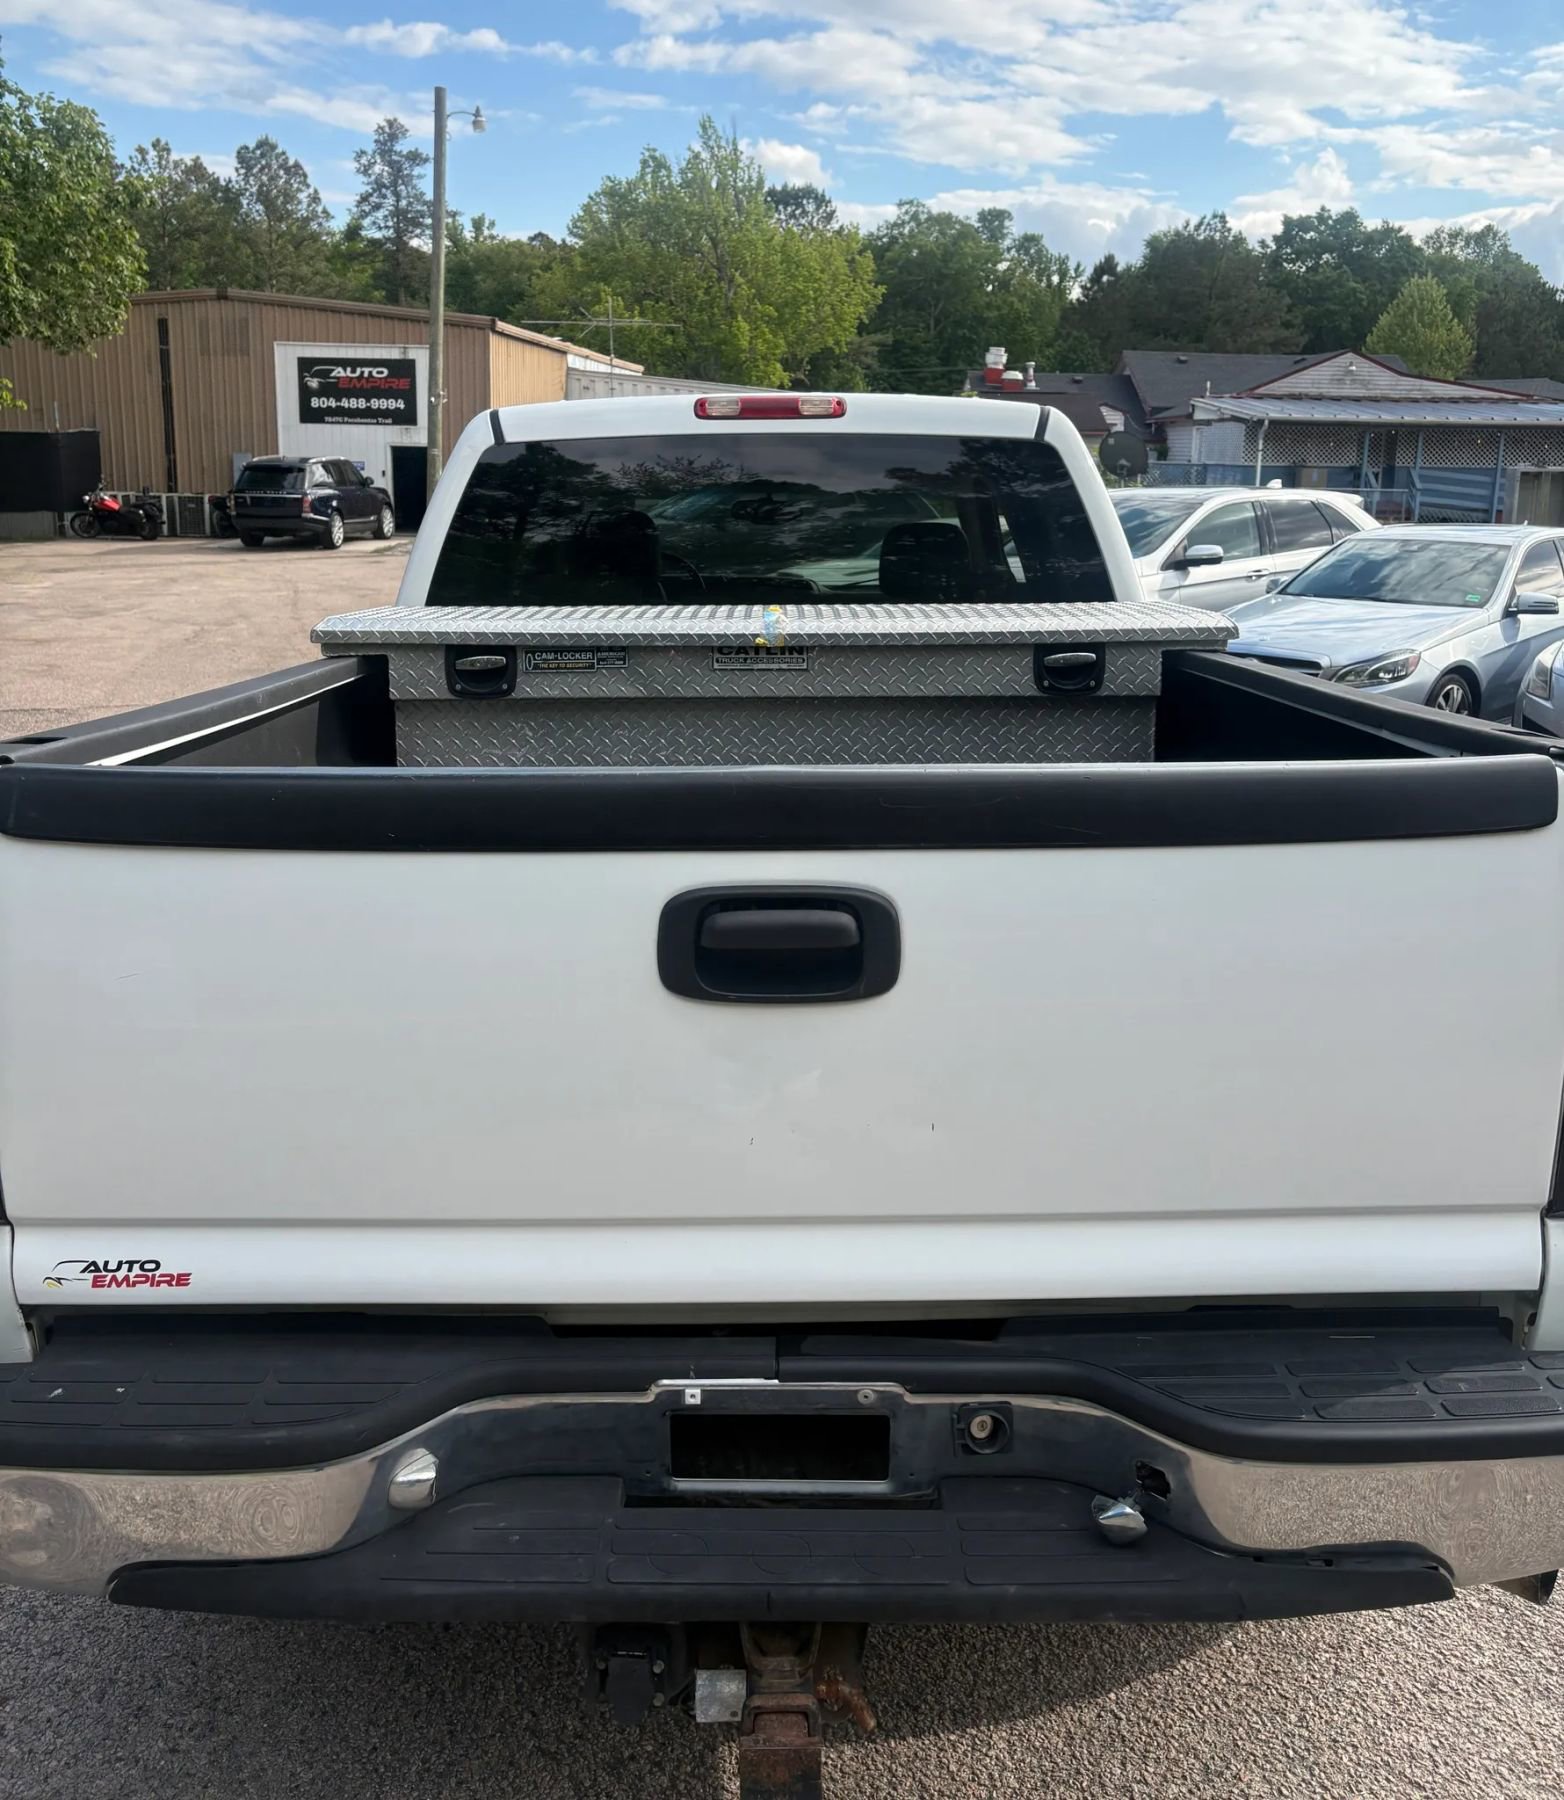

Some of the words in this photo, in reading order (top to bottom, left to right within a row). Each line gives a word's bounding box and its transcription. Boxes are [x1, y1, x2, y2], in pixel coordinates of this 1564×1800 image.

[330, 367, 389, 377] AUTO
[338, 378, 411, 390] EMPIRE
[310, 397, 406, 409] 804-488-9994
[535, 652, 593, 661] CAM-LOCKER
[80, 1260, 161, 1273] AUTO
[91, 1273, 192, 1288] EMPIRE
